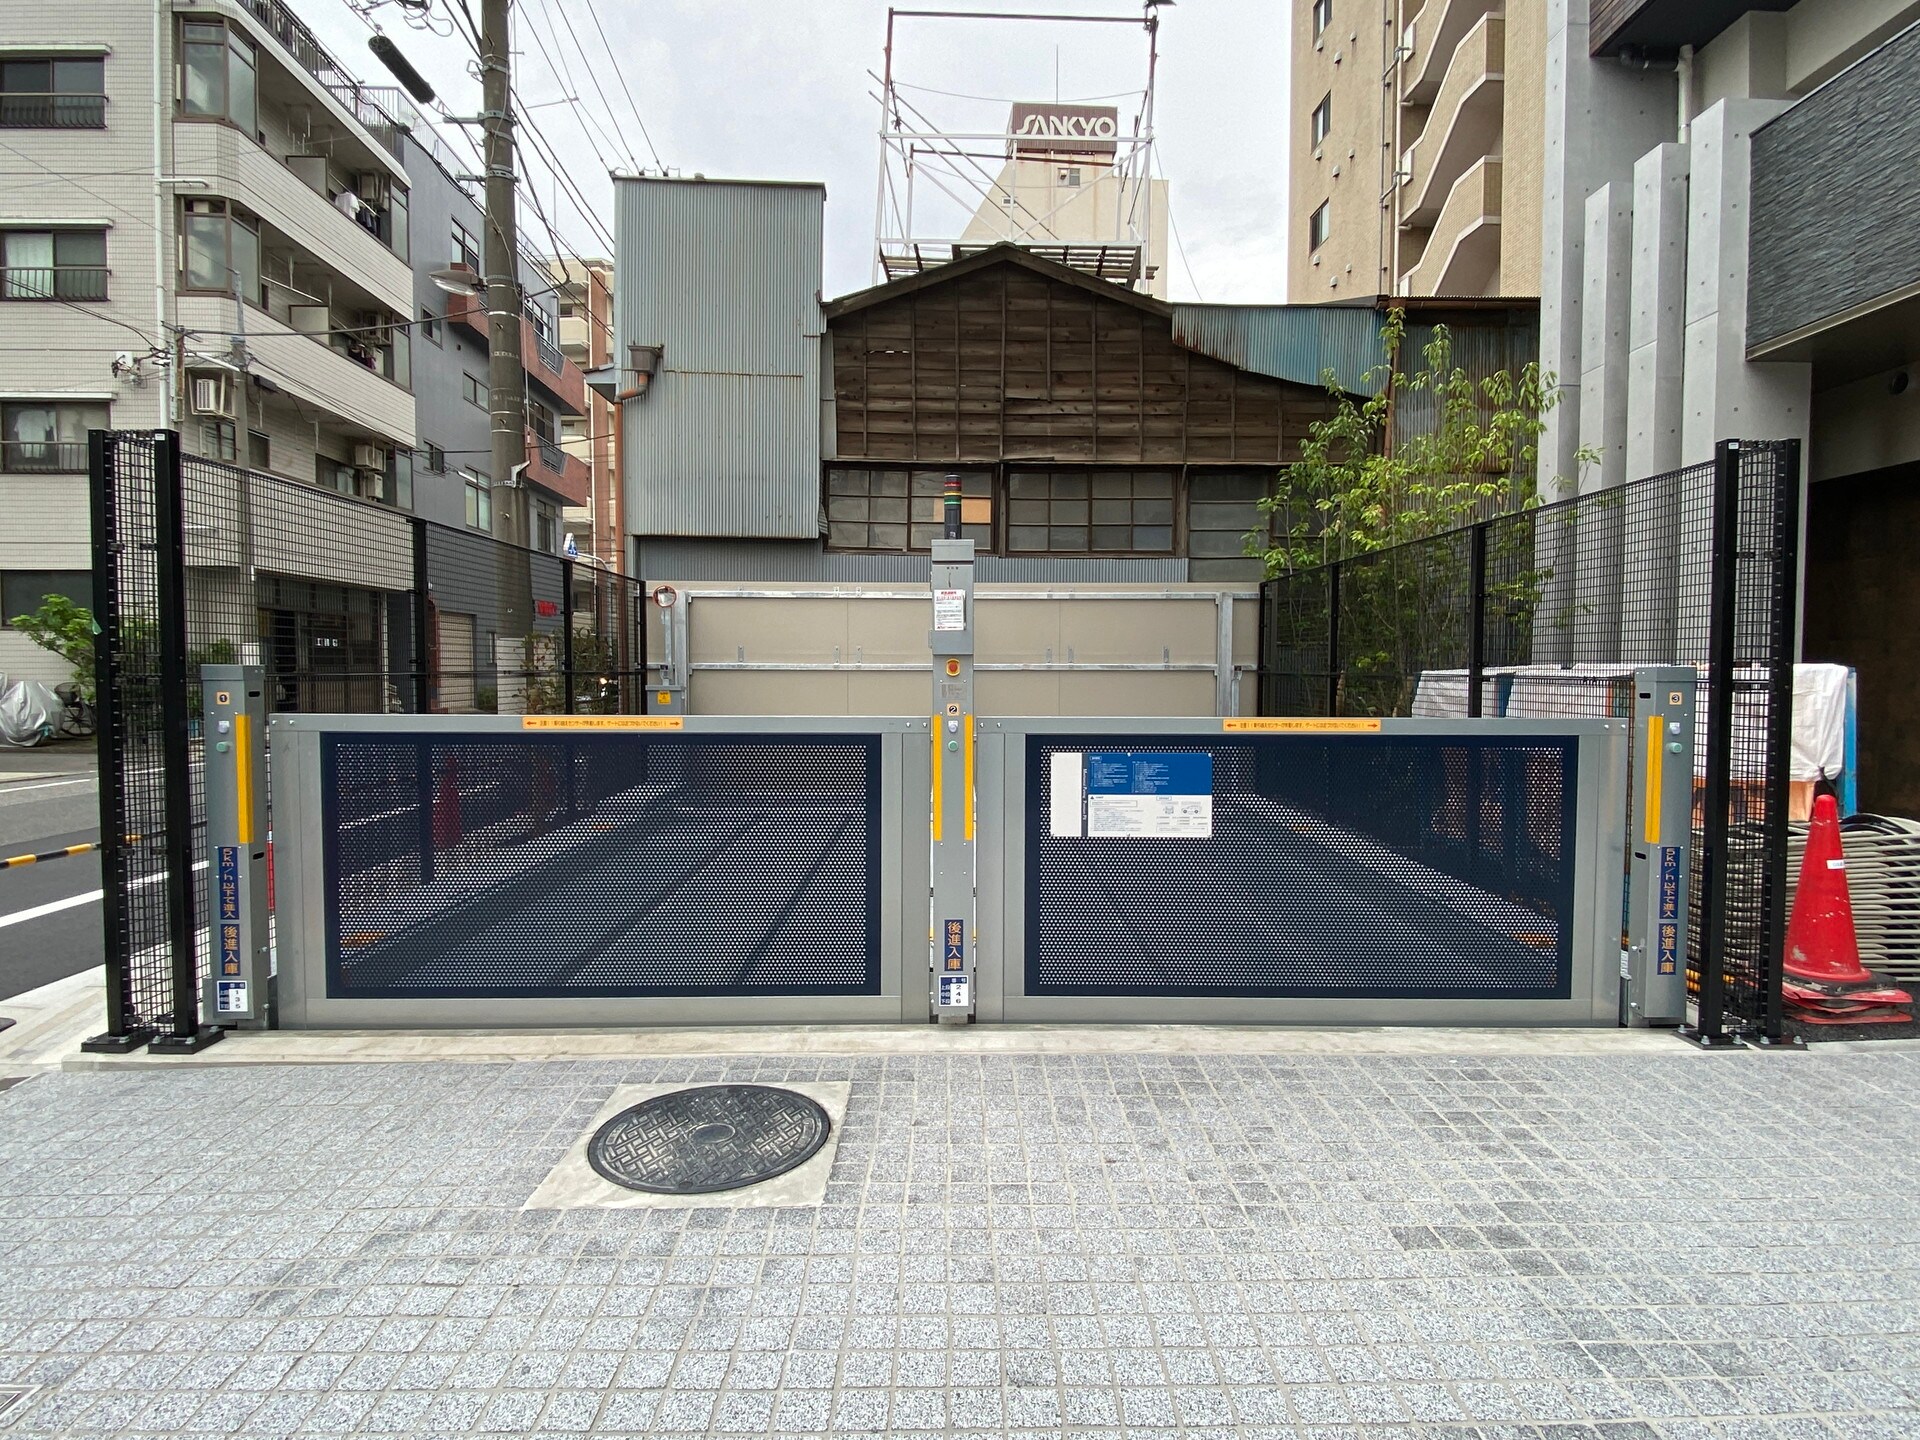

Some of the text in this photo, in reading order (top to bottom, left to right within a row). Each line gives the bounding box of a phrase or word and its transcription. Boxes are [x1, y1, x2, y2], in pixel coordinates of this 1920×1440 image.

[1015, 114, 1116, 138] SANKYO
[947, 921, 962, 970] 後進入庫
